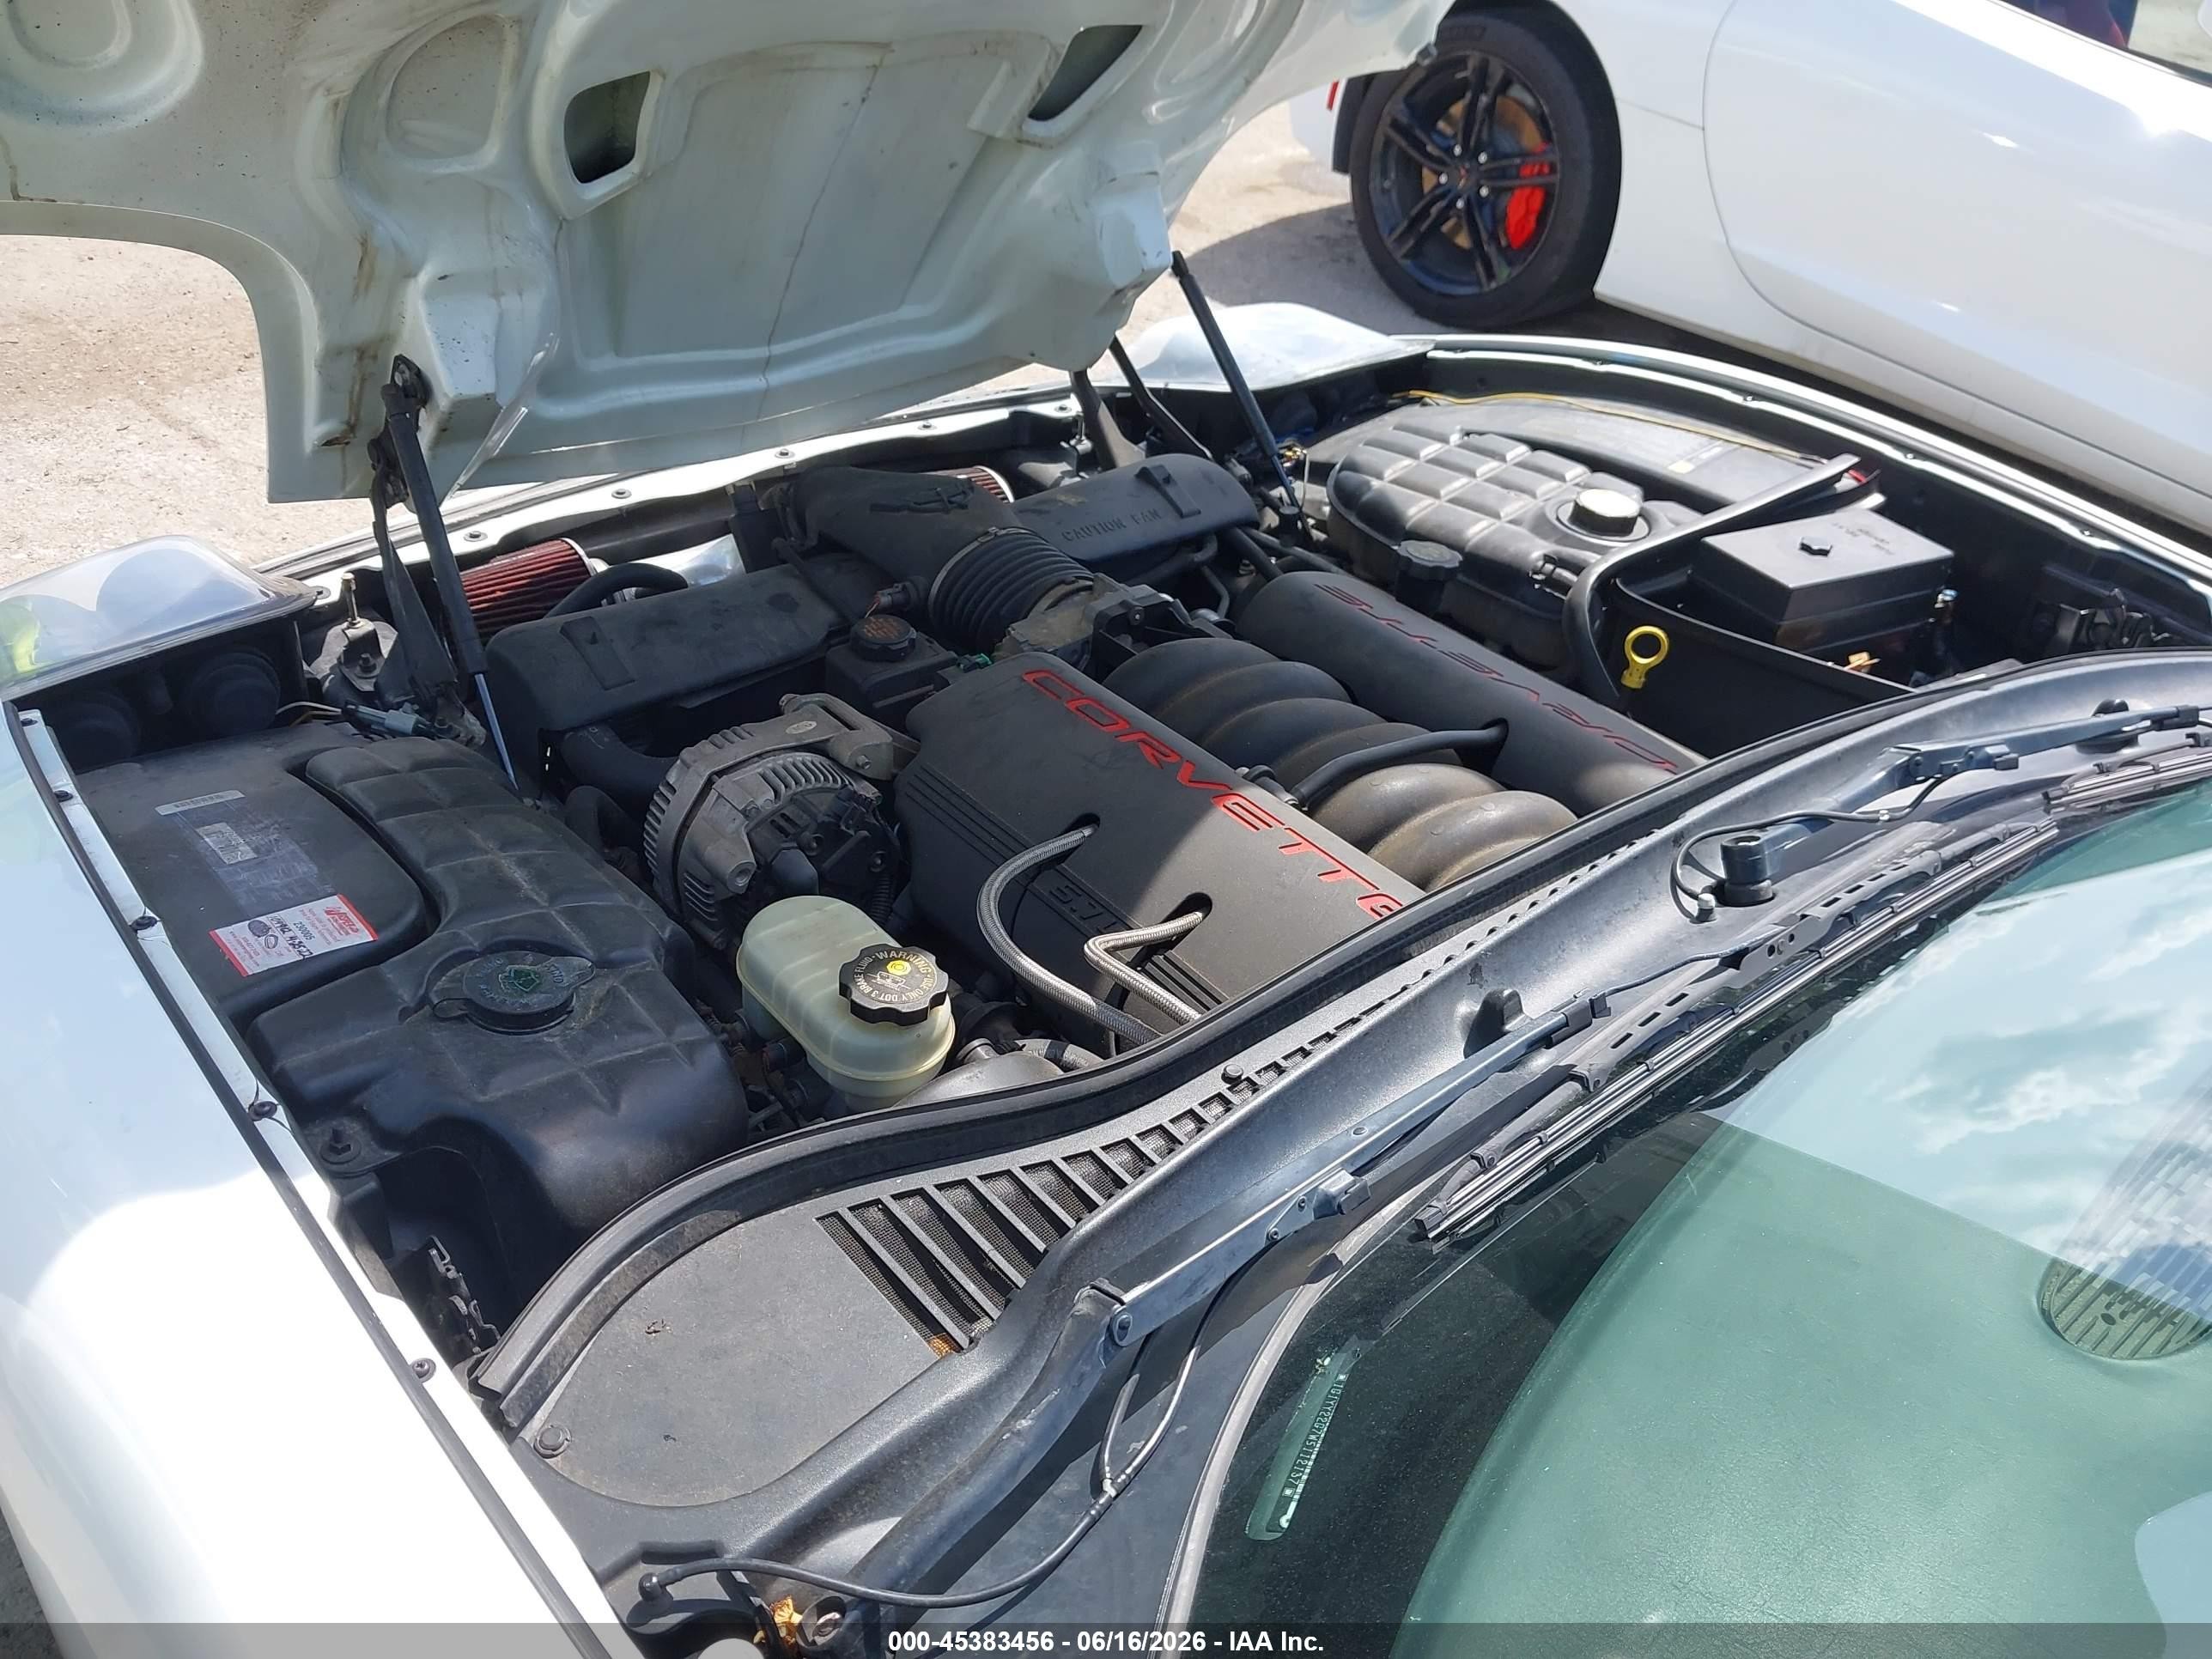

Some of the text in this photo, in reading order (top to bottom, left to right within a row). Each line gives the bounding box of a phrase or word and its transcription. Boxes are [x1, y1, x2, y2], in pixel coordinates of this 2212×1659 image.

[1061, 507, 1162, 541] CAUTION FAN
[293, 921, 317, 941] 230005
[854, 957, 873, 973] FLUID
[876, 951, 931, 974] WARNING
[854, 973, 872, 994] BRAKE
[878, 993, 897, 1001] DOT
[902, 988, 923, 1001] ONLY
[1288, 1383, 1344, 1485] 1G1YY22G7W5112137
